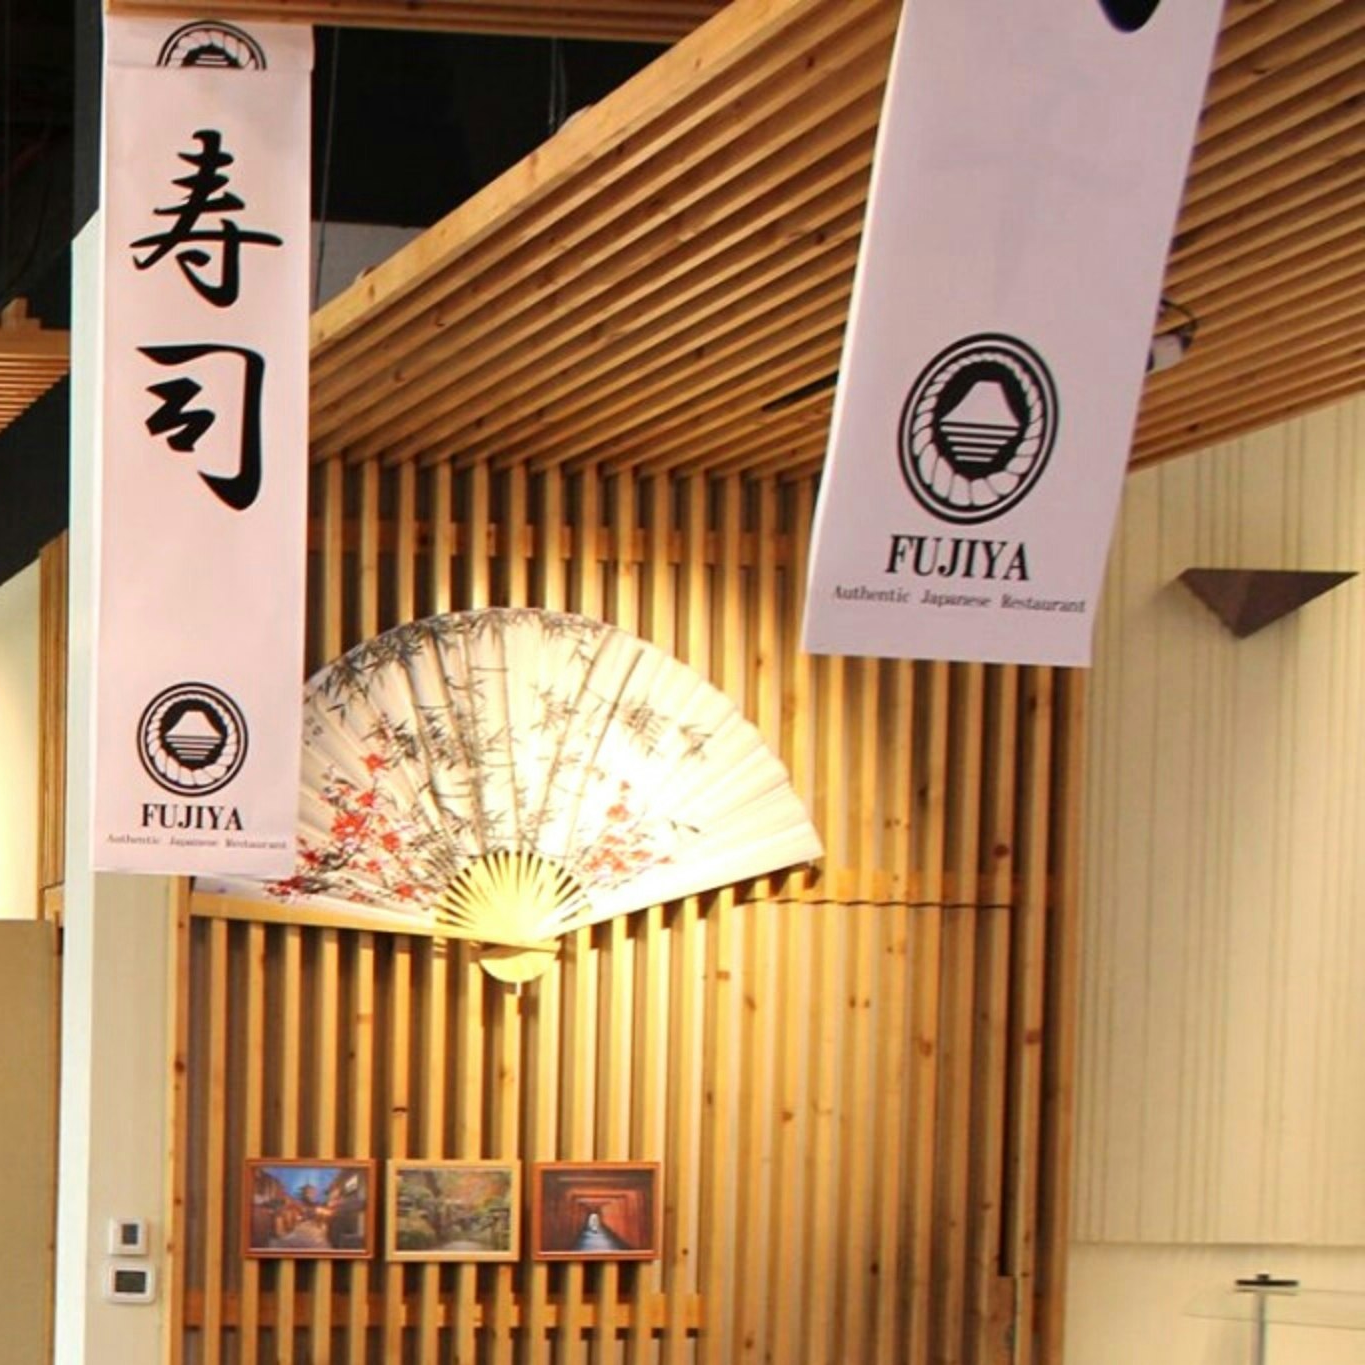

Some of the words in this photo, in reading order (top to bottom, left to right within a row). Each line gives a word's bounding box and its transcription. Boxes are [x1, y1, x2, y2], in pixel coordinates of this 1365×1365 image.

[130, 130, 283, 511] 寿司
[885, 534, 1029, 581] FUJIYA
[833, 585, 910, 603] Authentic
[921, 590, 992, 608] Japanese
[1001, 594, 1086, 613] Restaurant
[141, 803, 245, 831] FUJIYA
